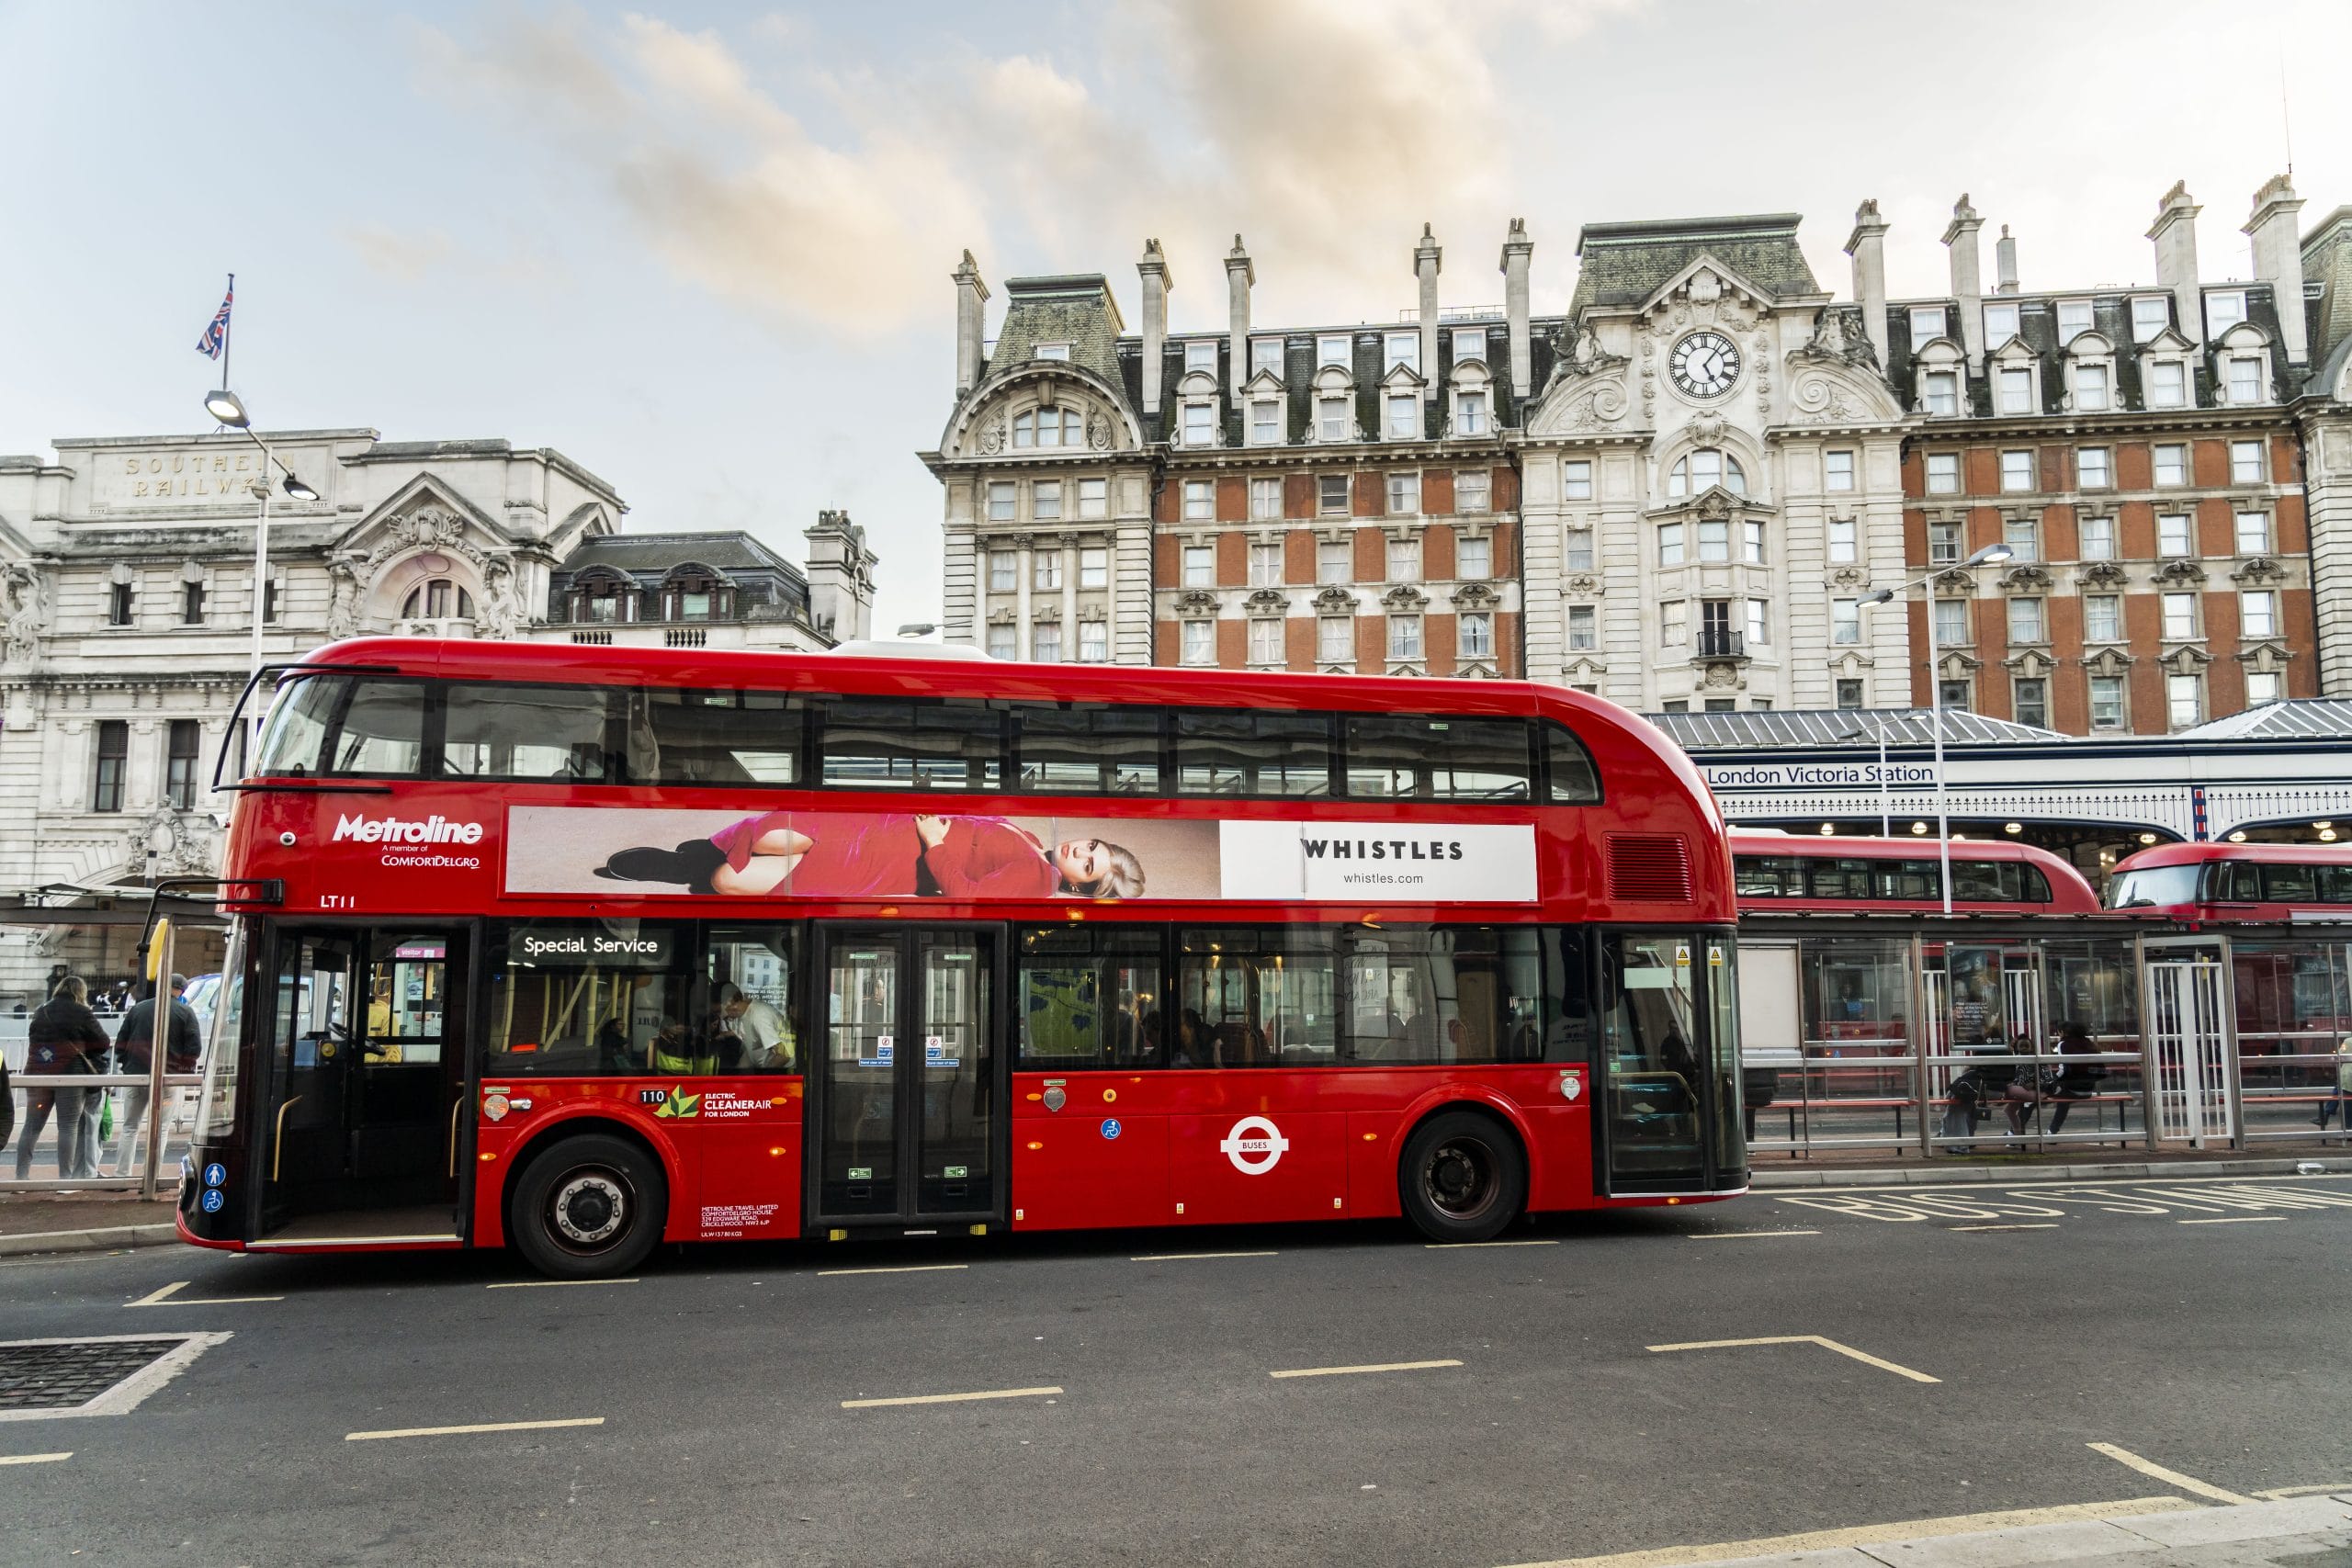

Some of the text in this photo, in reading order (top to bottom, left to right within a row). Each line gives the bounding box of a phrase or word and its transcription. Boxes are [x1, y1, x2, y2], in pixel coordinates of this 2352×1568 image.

[1708, 764, 1934, 784] London Victoria Station
[332, 813, 483, 844] Metroline
[421, 844, 428, 852] of
[1300, 838, 1464, 860] WHISTLES
[1343, 873, 1424, 884] whistles.com
[524, 936, 658, 957] Special Service
[642, 1091, 664, 1102] 110
[704, 1100, 772, 1110] CLEANERAIR
